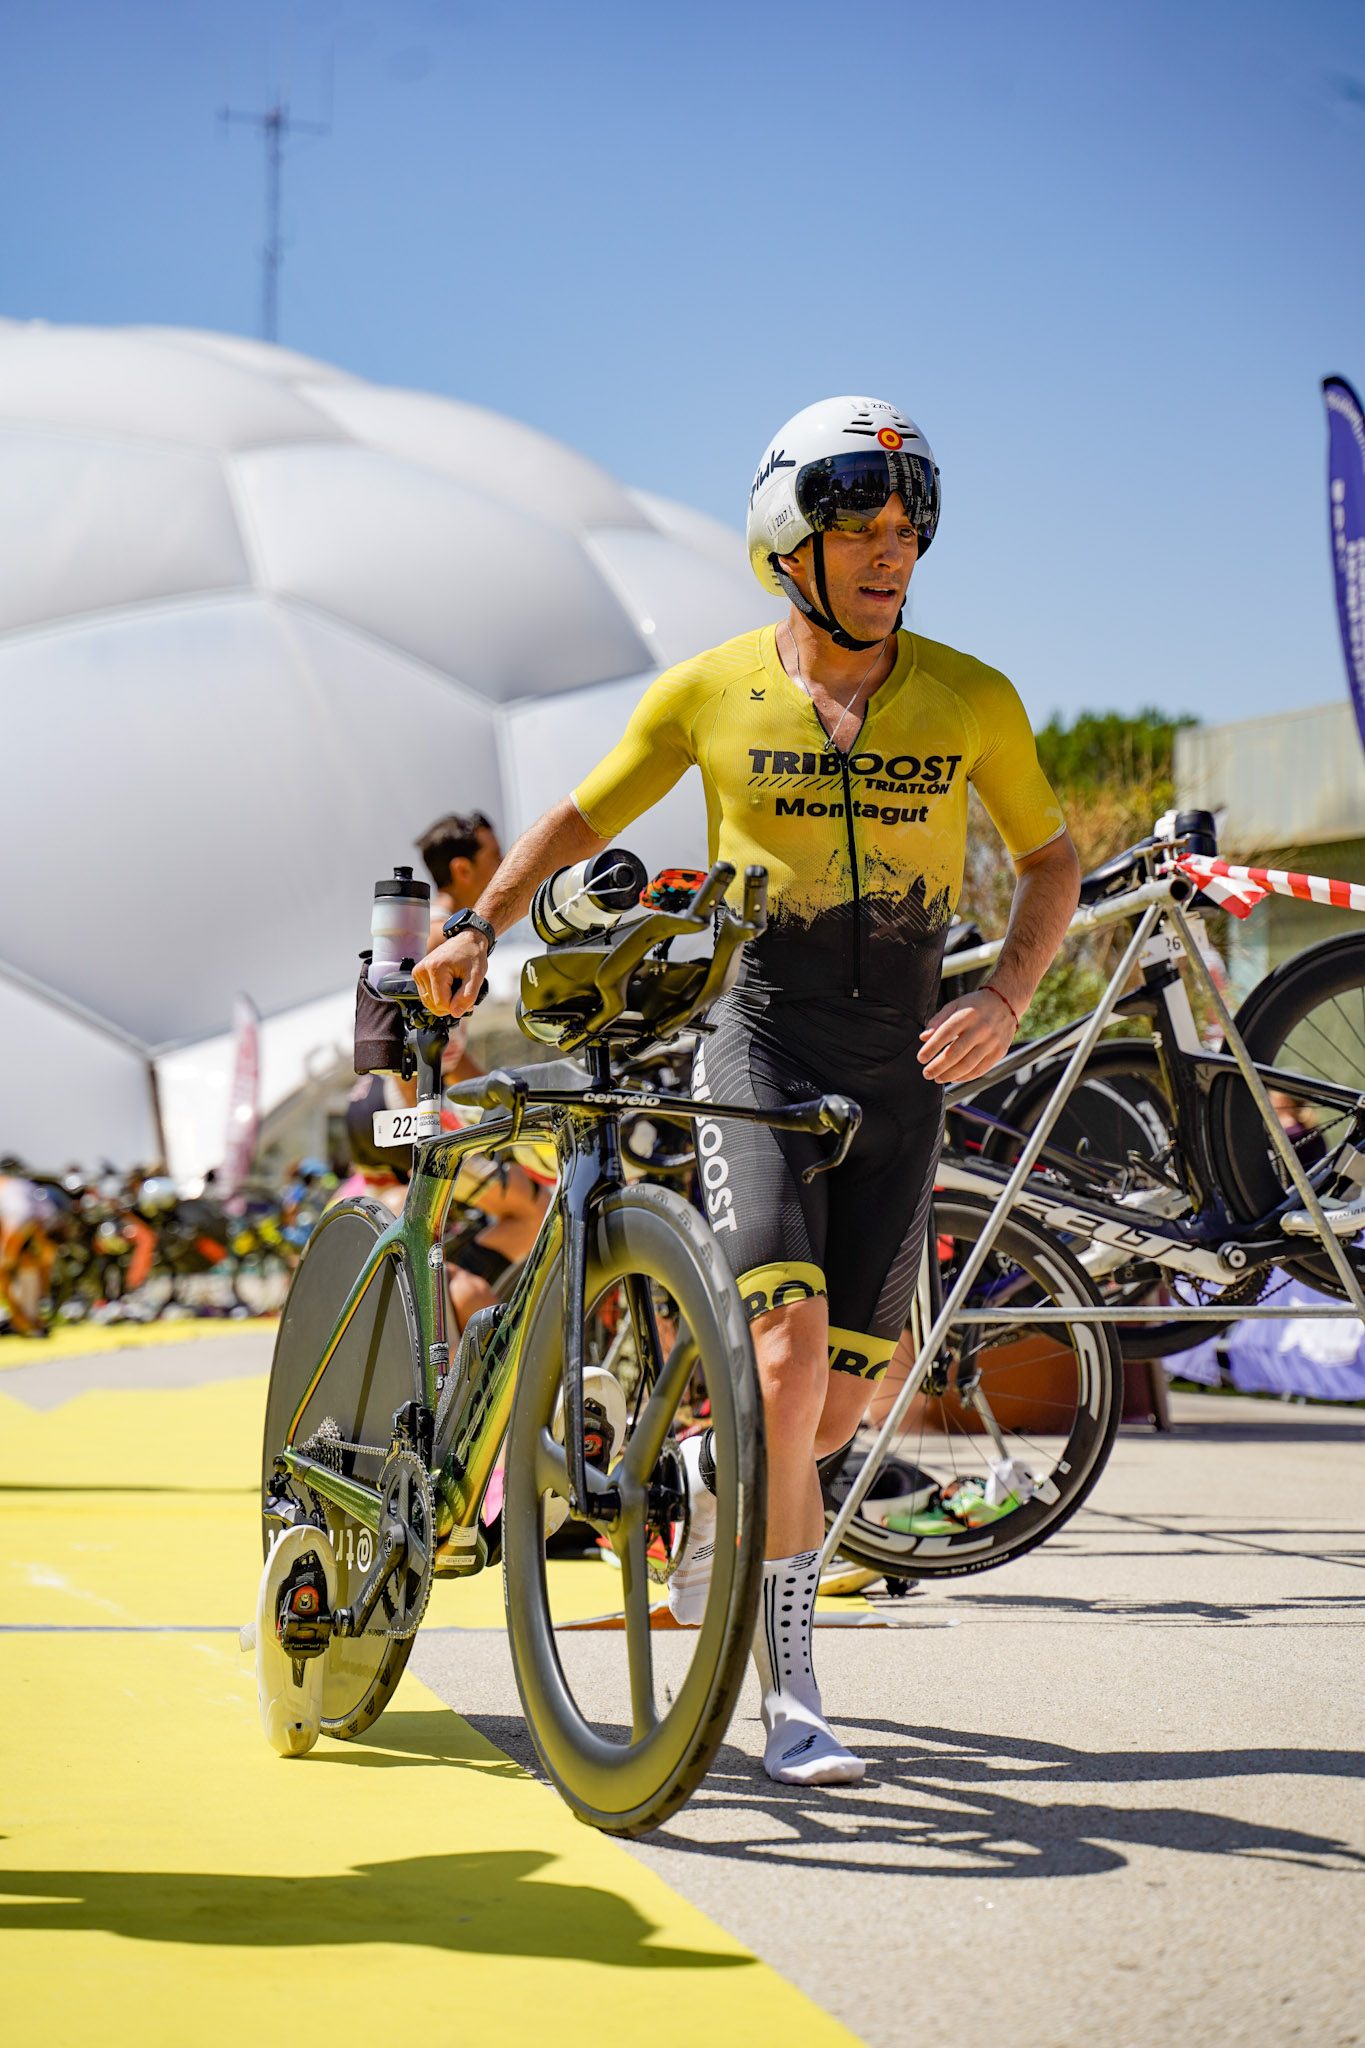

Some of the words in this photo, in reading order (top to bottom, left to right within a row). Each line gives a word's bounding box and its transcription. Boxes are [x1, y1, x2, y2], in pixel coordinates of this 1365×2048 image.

[774, 509, 789, 528] 2217
[748, 748, 963, 782] TRIBOOST
[864, 778, 951, 795] TRIATLÓN
[775, 797, 929, 826] Montagut
[393, 1115, 417, 1139] 22
